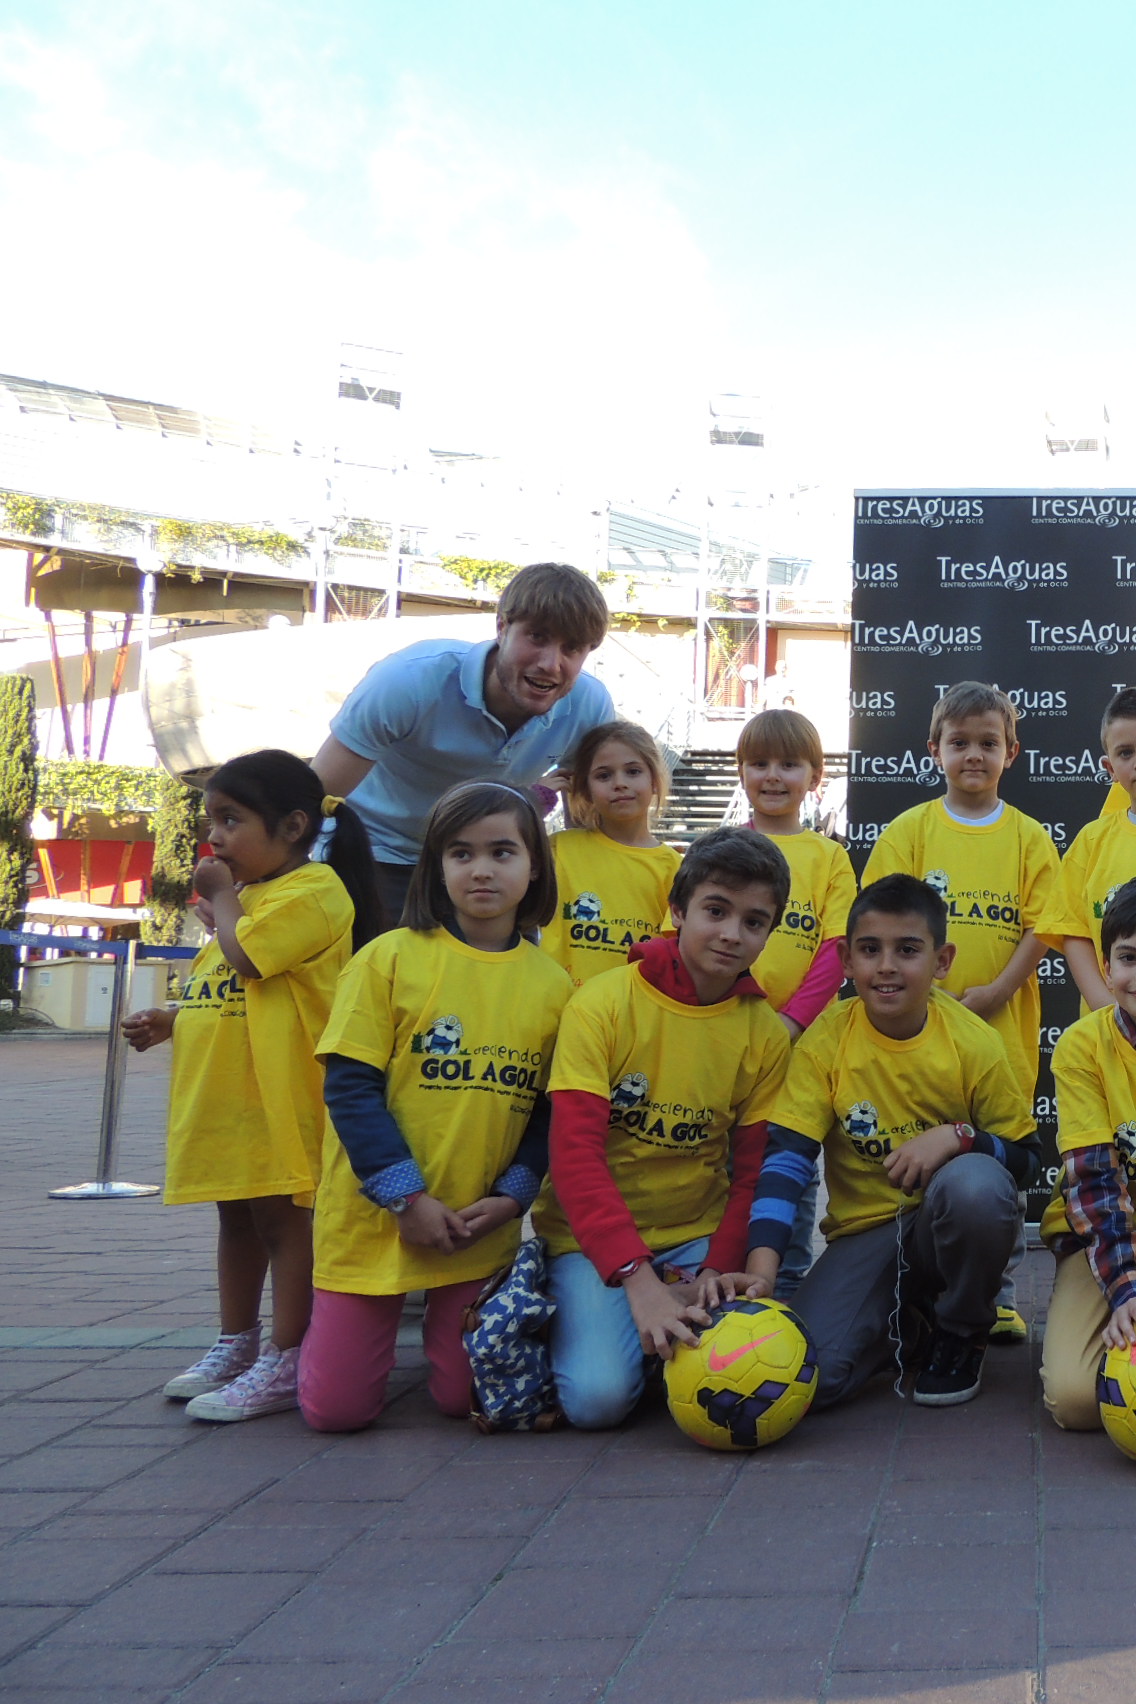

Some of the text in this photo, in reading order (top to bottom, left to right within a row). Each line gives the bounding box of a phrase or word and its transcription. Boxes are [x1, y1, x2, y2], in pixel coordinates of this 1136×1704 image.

[858, 498, 984, 523] TresAguas
[937, 555, 1068, 585] TresAguas
[852, 620, 982, 650] TresAguas
[610, 918, 662, 934] creciend
[785, 912, 816, 932] GO
[968, 902, 983, 919] A
[986, 904, 1021, 926] GOL
[571, 923, 615, 945] GOL
[620, 930, 633, 947] A
[474, 1044, 542, 1066] creciendo
[420, 1058, 475, 1081] GOL
[481, 1061, 498, 1083] A
[499, 1065, 540, 1092] GOL
[608, 1108, 648, 1132] GOL
[646, 1118, 666, 1138] A
[671, 1122, 708, 1142] GOL
